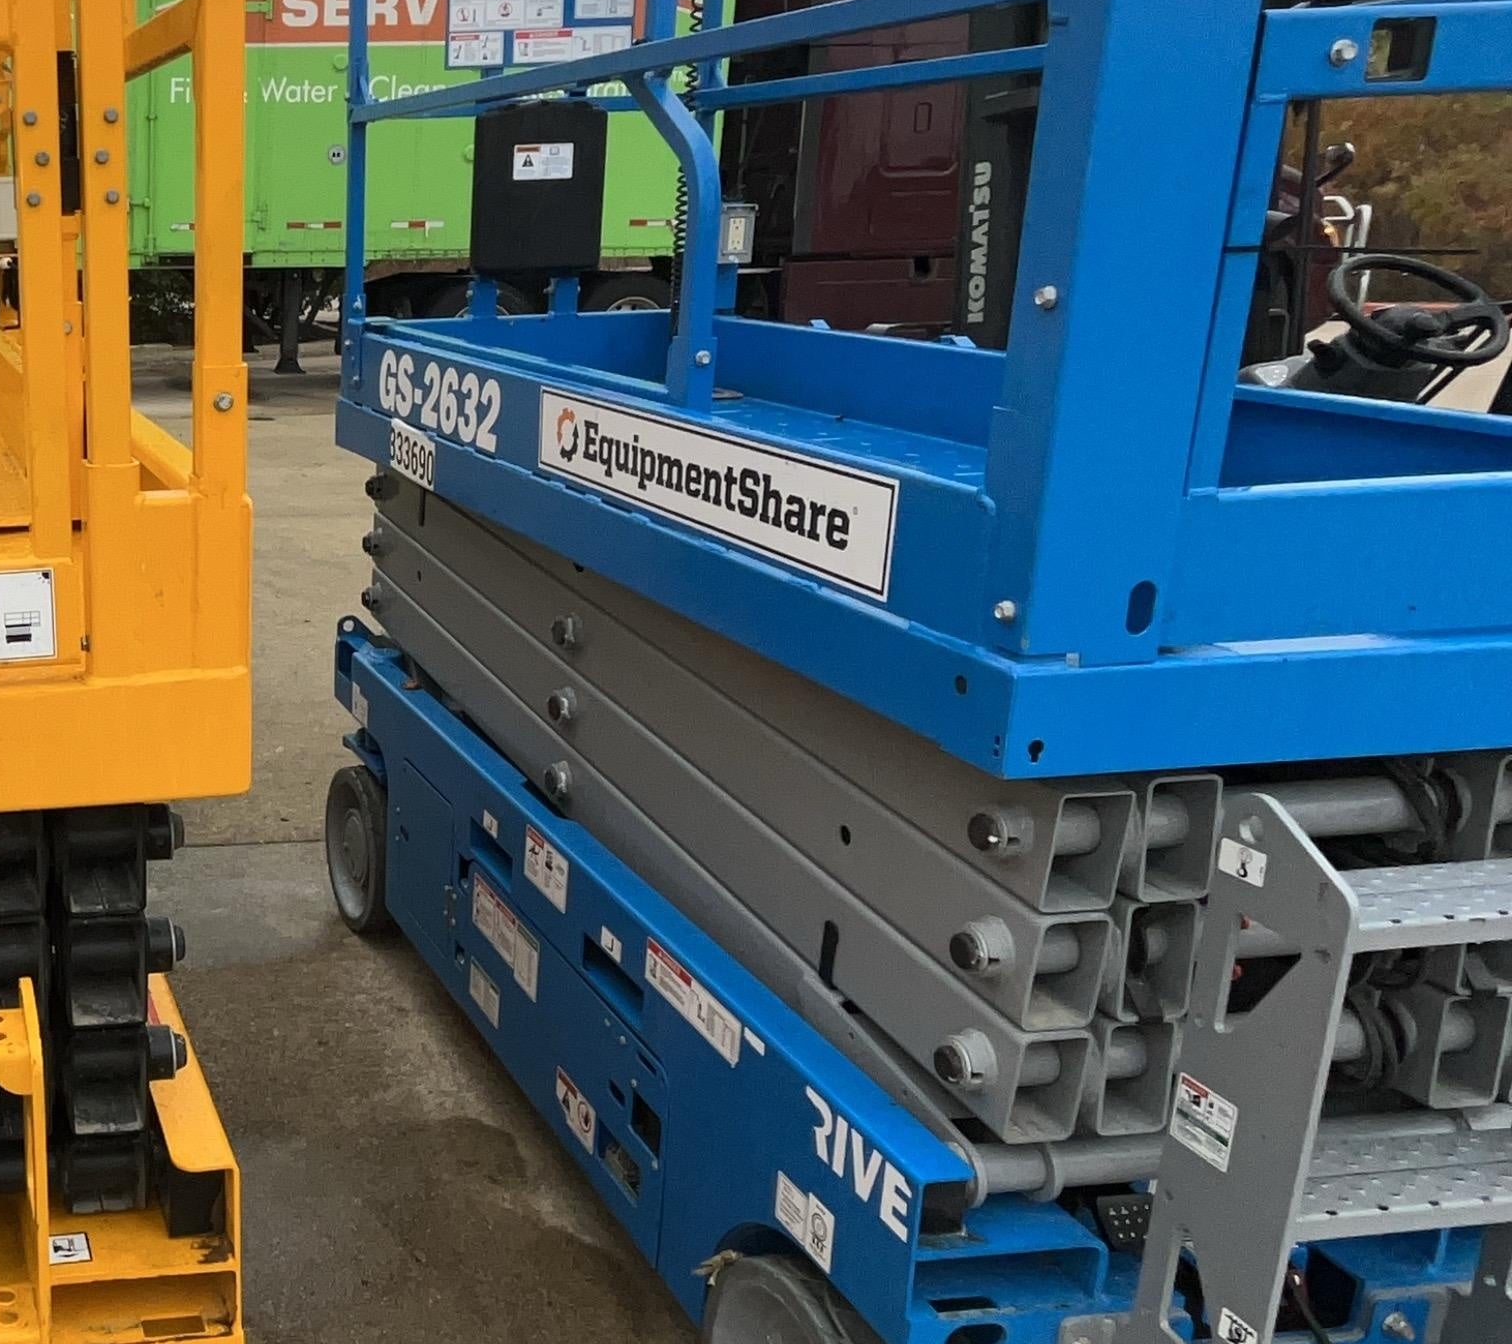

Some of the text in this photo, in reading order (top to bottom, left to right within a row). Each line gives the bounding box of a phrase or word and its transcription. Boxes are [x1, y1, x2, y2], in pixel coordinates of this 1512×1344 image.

[170, 77, 191, 103] Fi
[261, 76, 339, 103] Water
[967, 161, 992, 323] KOMATSU
[379, 348, 501, 453] GS-2632
[583, 419, 851, 552] EquipmentShare
